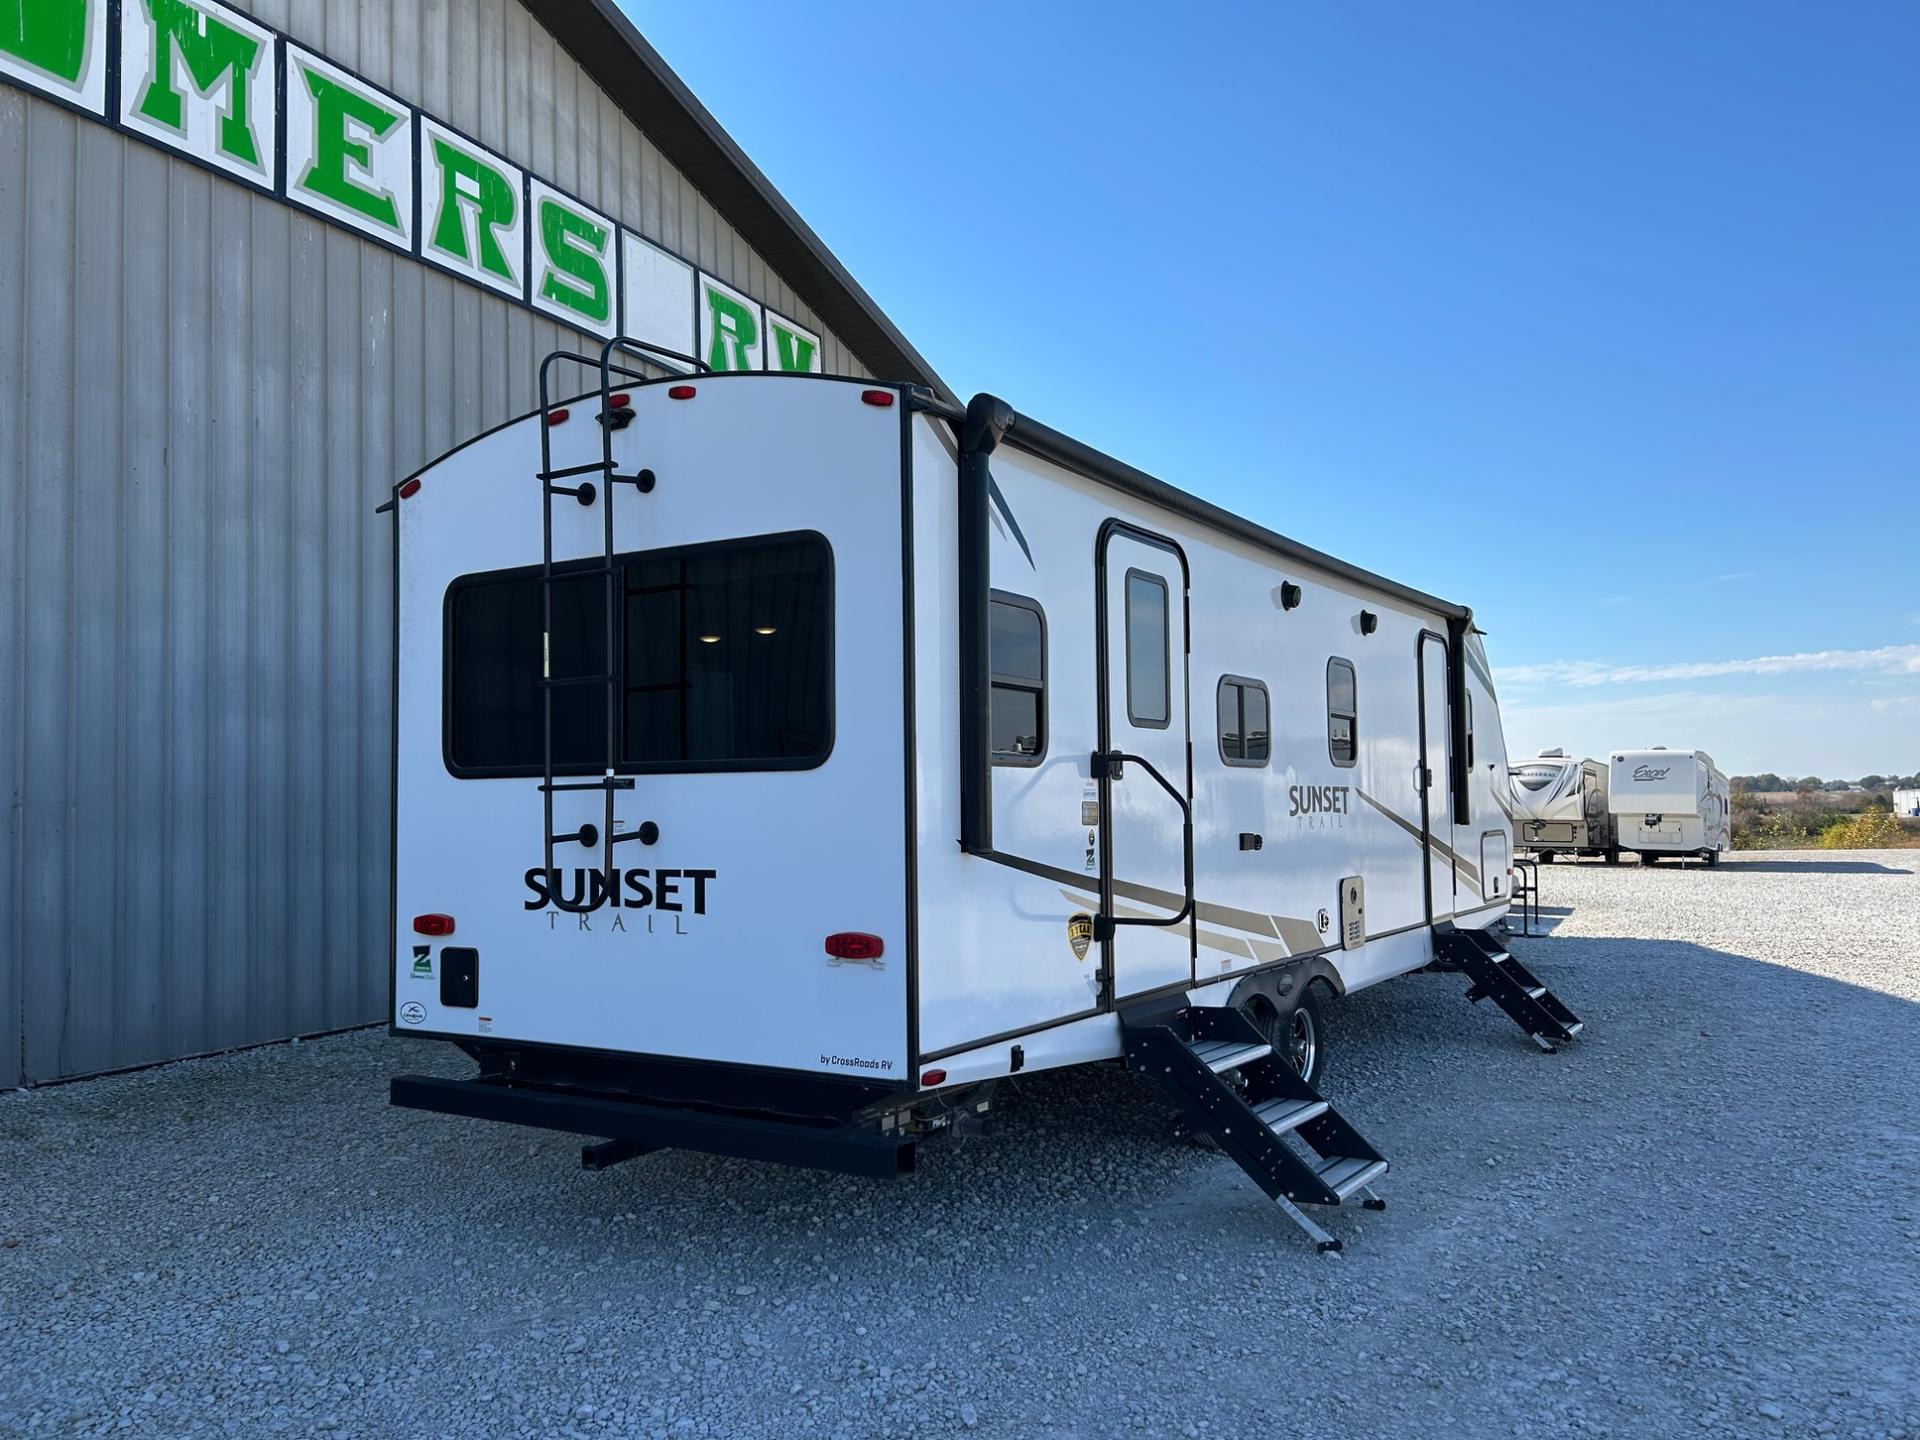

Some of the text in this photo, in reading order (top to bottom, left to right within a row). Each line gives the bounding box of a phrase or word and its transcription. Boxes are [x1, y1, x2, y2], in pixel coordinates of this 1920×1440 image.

[704, 281, 817, 371] RV
[1633, 765, 1670, 780] Excel
[1289, 785, 1349, 817] SUNSET
[1297, 815, 1343, 830] TRAIL
[524, 867, 717, 915] SUNSET
[546, 911, 688, 935] TRAIL
[820, 1054, 893, 1070] by CrossRoads RV
